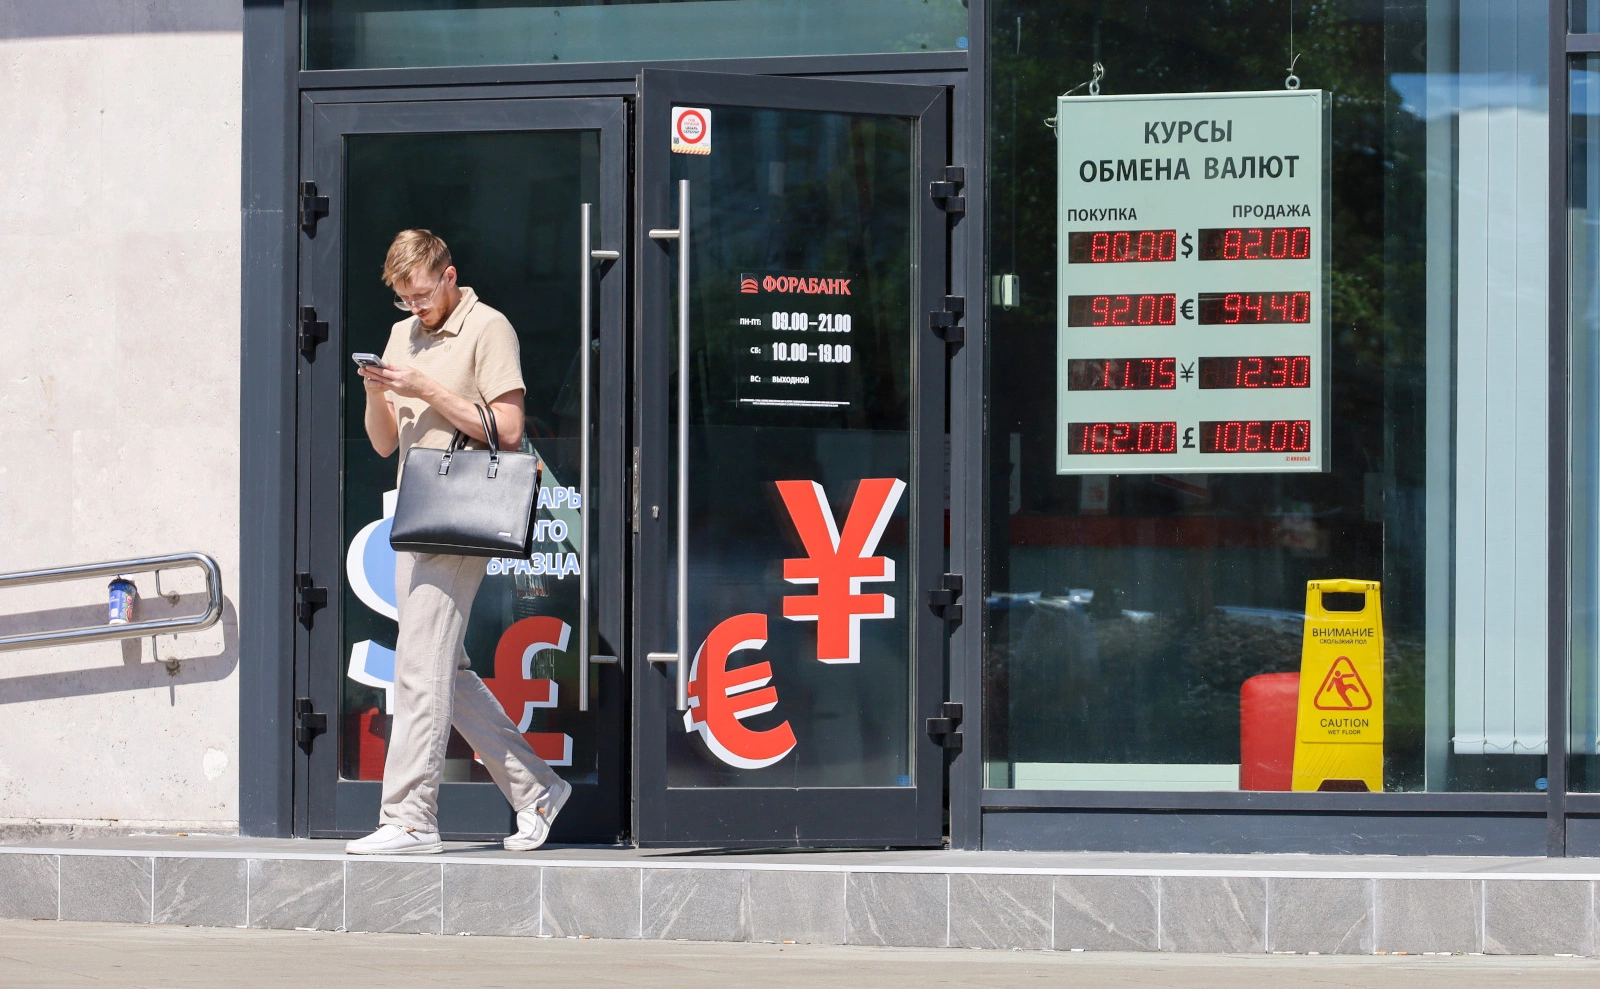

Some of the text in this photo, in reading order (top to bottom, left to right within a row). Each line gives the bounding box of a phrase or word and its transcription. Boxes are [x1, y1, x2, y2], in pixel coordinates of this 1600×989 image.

[1144, 120, 1233, 144] КУРСЫ
[1079, 156, 1300, 182] ОБМЕНА ВАЛЮТ
[1067, 205, 1311, 221] ПОКУПКА ПРОДАЖА
[1092, 228, 1310, 262] 80.00 $ 82.00
[762, 275, 851, 295] ФОРАБАНК
[1093, 293, 1309, 325] 92.00 € 94.40
[772, 376, 809, 384] ВЫХОДНОЙ
[1104, 357, 1309, 388] 11.75 ¥ 12.30
[1083, 422, 1309, 452] 102.00 £ 106.00
[486, 552, 580, 580] БРАЗЦА
[775, 478, 906, 664] ¥
[1312, 628, 1374, 637] ВНИМАНИЕ
[683, 613, 797, 769] €
[1320, 718, 1369, 728] CAUTION
